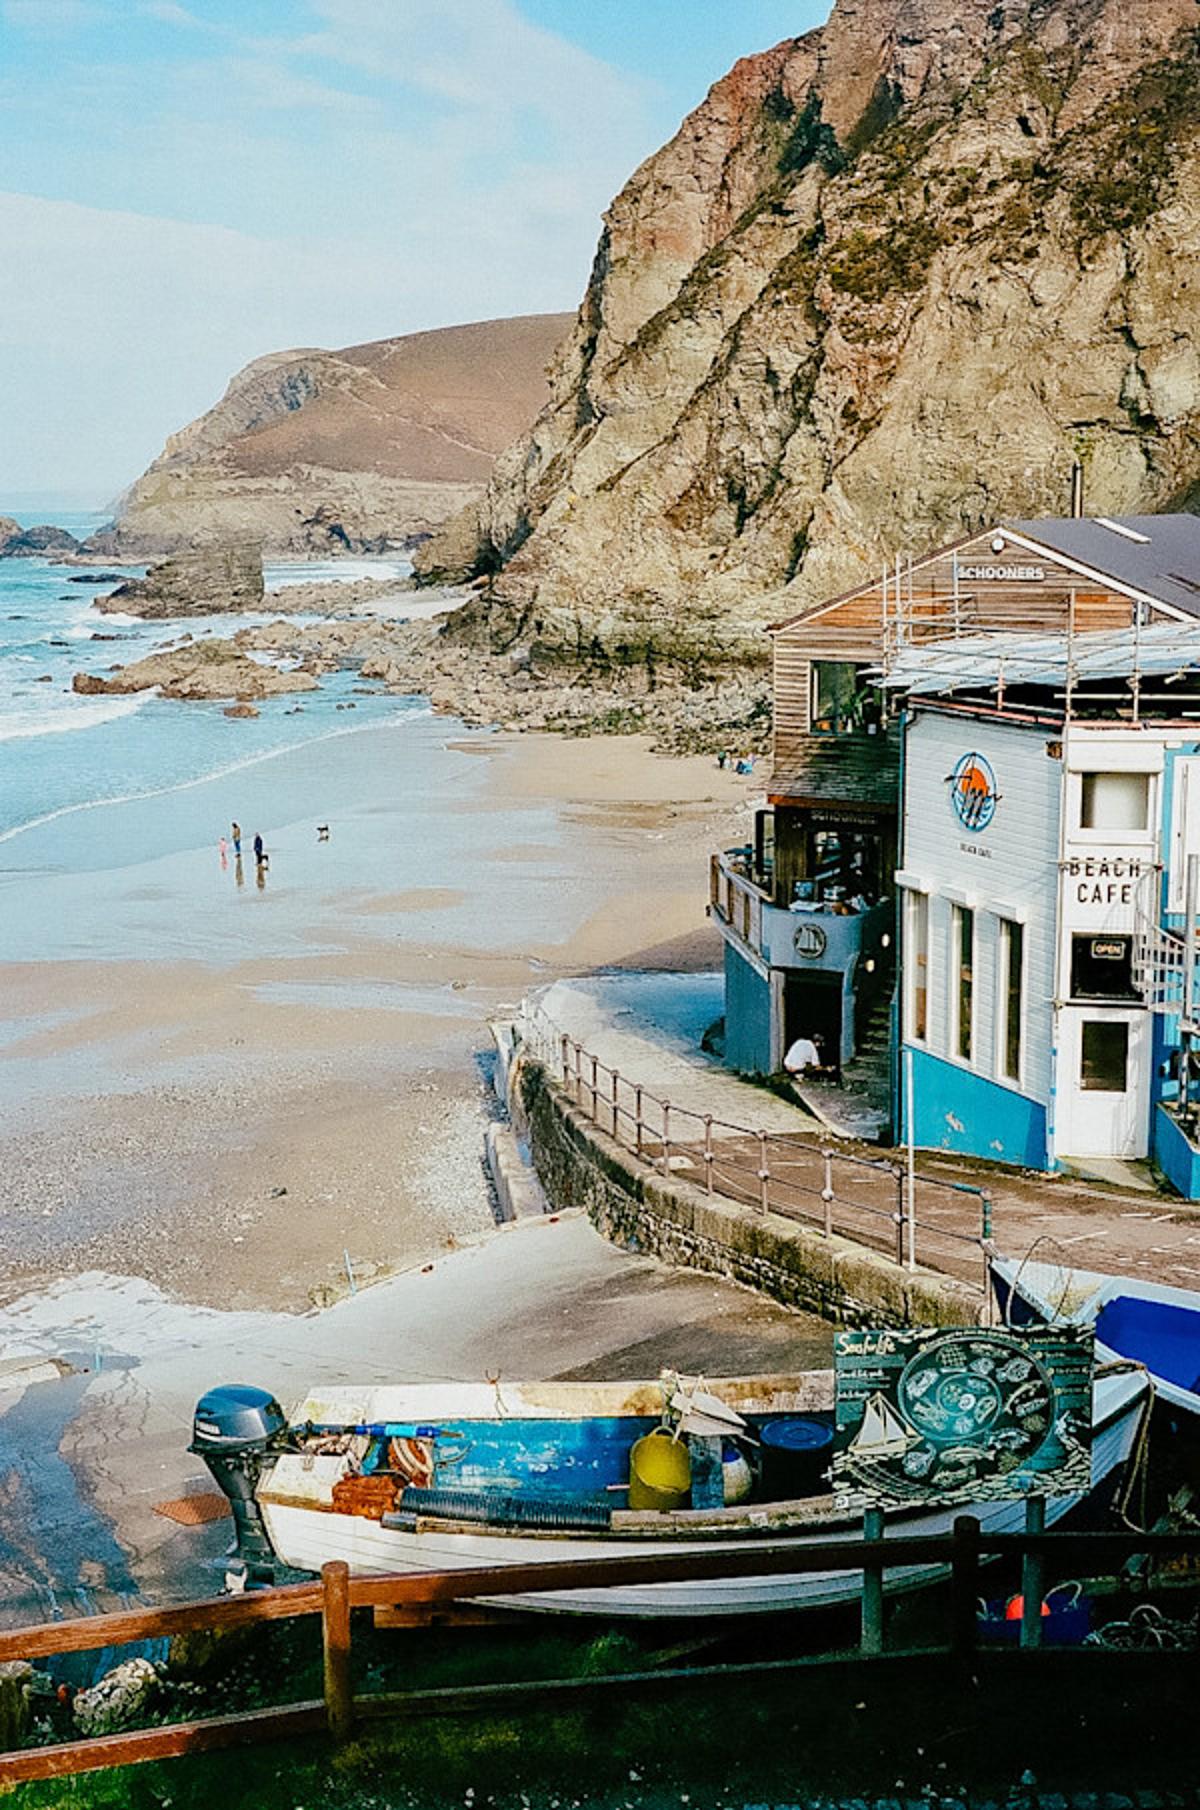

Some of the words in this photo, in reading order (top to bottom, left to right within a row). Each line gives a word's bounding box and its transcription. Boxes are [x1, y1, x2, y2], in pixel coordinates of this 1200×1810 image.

[958, 566, 1044, 580] SCHOONERS
[1069, 857, 1141, 877] BEACH
[1077, 883, 1132, 904] CAFE
[1095, 943, 1121, 955] OPEN
